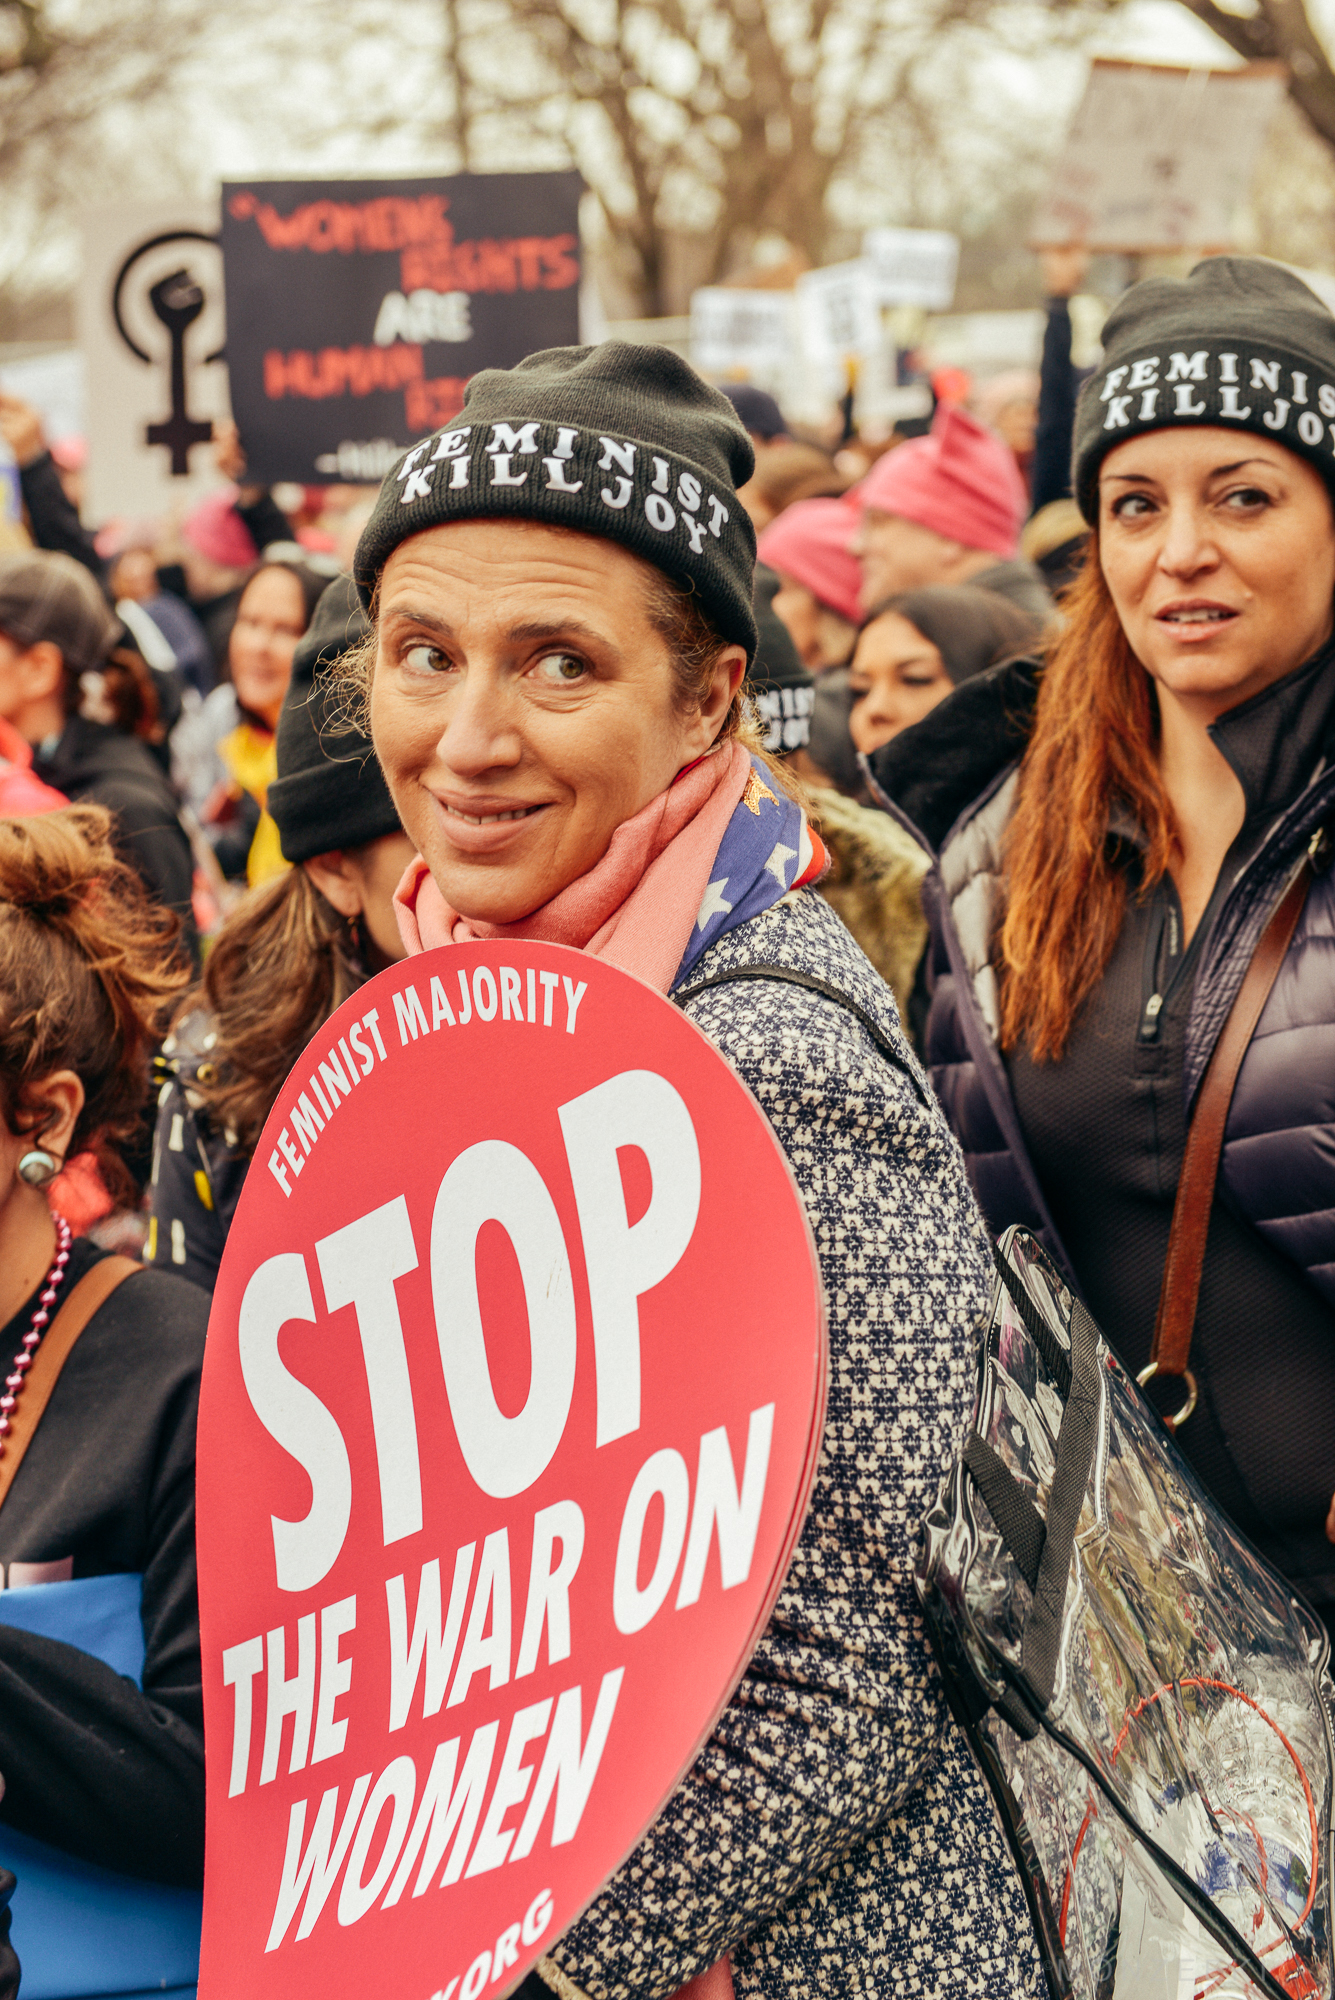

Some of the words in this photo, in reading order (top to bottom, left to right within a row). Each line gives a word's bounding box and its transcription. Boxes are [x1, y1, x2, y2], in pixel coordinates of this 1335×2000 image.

[263, 343, 425, 399] HUMAN
[373, 288, 473, 346] ARE
[396, 422, 729, 537] FEMINIST
[267, 1009, 388, 1198] FEMINIST
[392, 965, 588, 1047] MAJORITY
[238, 1069, 701, 1592] STOP
[222, 1594, 357, 1799] THE
[385, 1500, 585, 1733] WAR
[613, 1402, 775, 1635] ON
[264, 1666, 625, 1954] WOMEN
